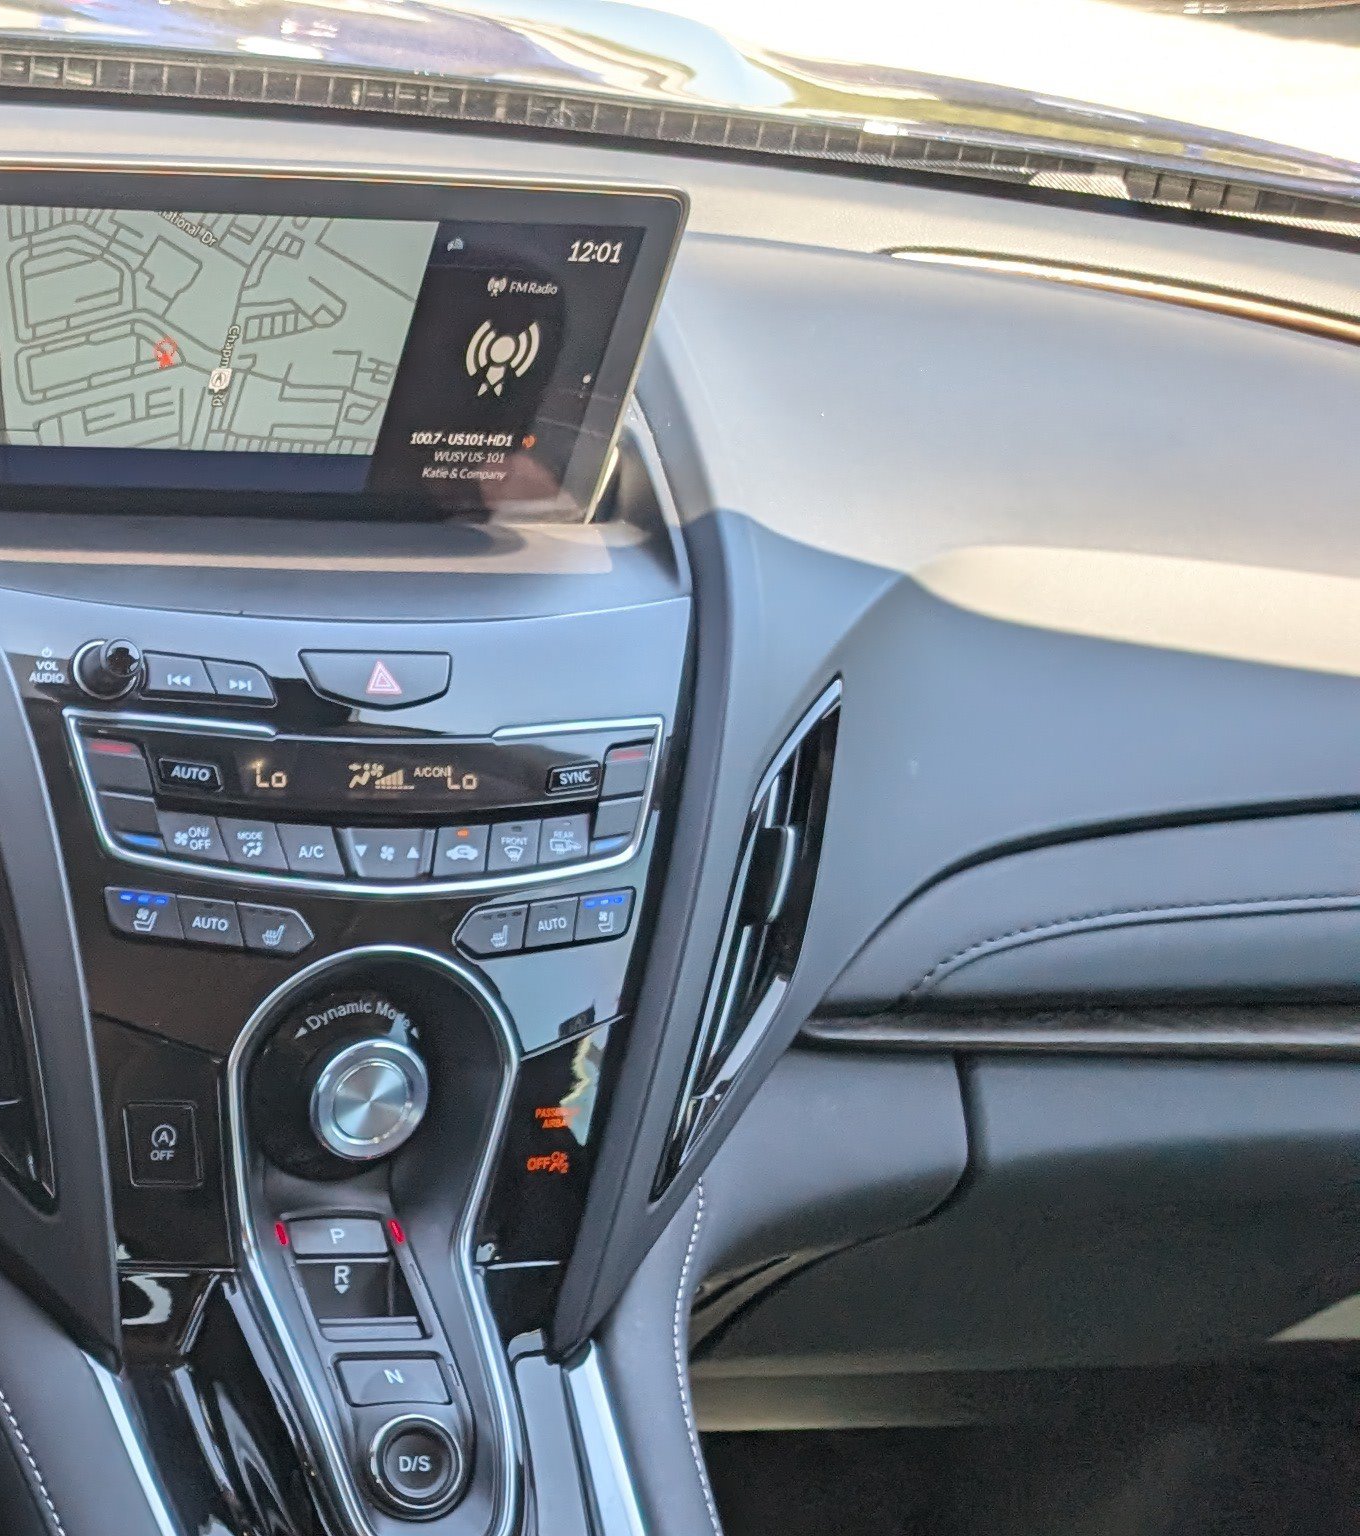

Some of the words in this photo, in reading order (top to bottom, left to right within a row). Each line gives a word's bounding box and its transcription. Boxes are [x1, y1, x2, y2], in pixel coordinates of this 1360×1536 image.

[201, 230, 217, 247] Dr
[567, 239, 623, 264] 12:01
[509, 281, 529, 293] FM
[529, 282, 558, 295] Radio
[219, 325, 241, 370] Chapm
[447, 432, 513, 447] US101-HD1
[433, 451, 468, 463] WUSY
[459, 469, 506, 482] Company
[35, 661, 59, 672] VOL
[29, 672, 65, 684] AUDIO
[170, 764, 211, 783] AUTO
[255, 764, 288, 788] Lo
[446, 765, 479, 790] Lo
[559, 770, 592, 785] SYNC
[237, 831, 263, 841] MODE
[500, 836, 528, 847] FRONT
[553, 830, 574, 840] REAR
[189, 839, 211, 851] OFF
[298, 845, 325, 860] A/C
[191, 915, 230, 932] AUTO
[536, 916, 567, 933] AUTO
[305, 1000, 373, 1031] Dynamic
[150, 1149, 175, 1162] OFF
[526, 1156, 551, 1171] OFF
[330, 1228, 346, 1244] P
[333, 1266, 352, 1285] R
[383, 1369, 404, 1386] N
[398, 1455, 432, 1474] D/S
